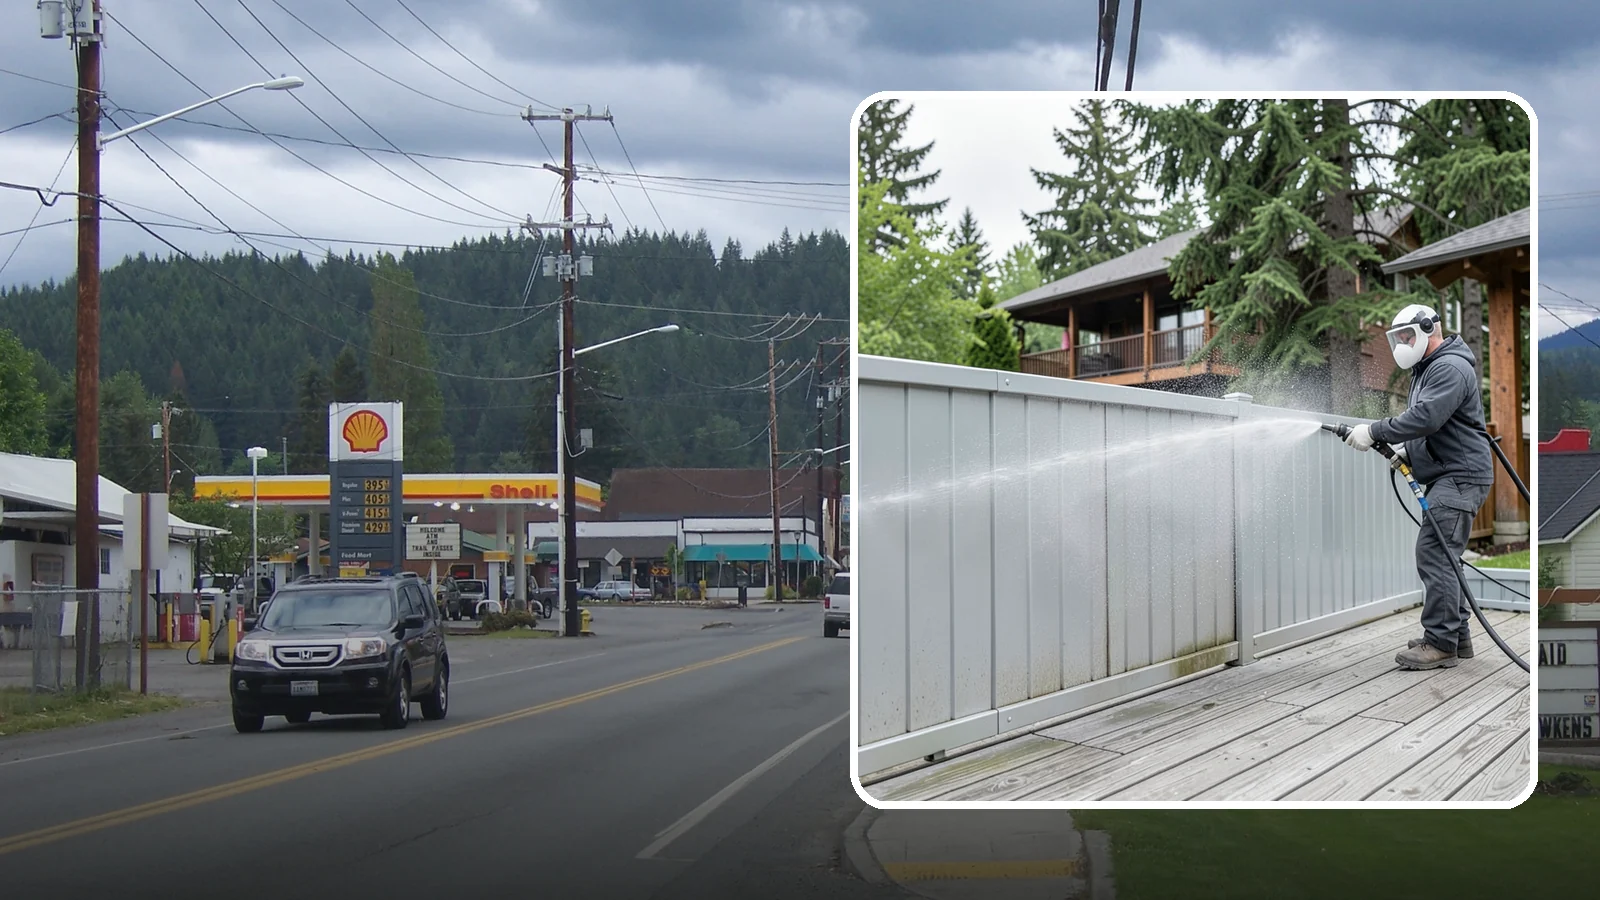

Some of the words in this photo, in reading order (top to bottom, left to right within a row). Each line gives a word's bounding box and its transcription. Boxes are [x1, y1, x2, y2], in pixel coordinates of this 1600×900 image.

[366, 480, 383, 490] 395
[490, 484, 547, 498] Shell
[366, 494, 383, 504] 405
[366, 508, 383, 518] 415
[366, 522, 383, 532] 429
